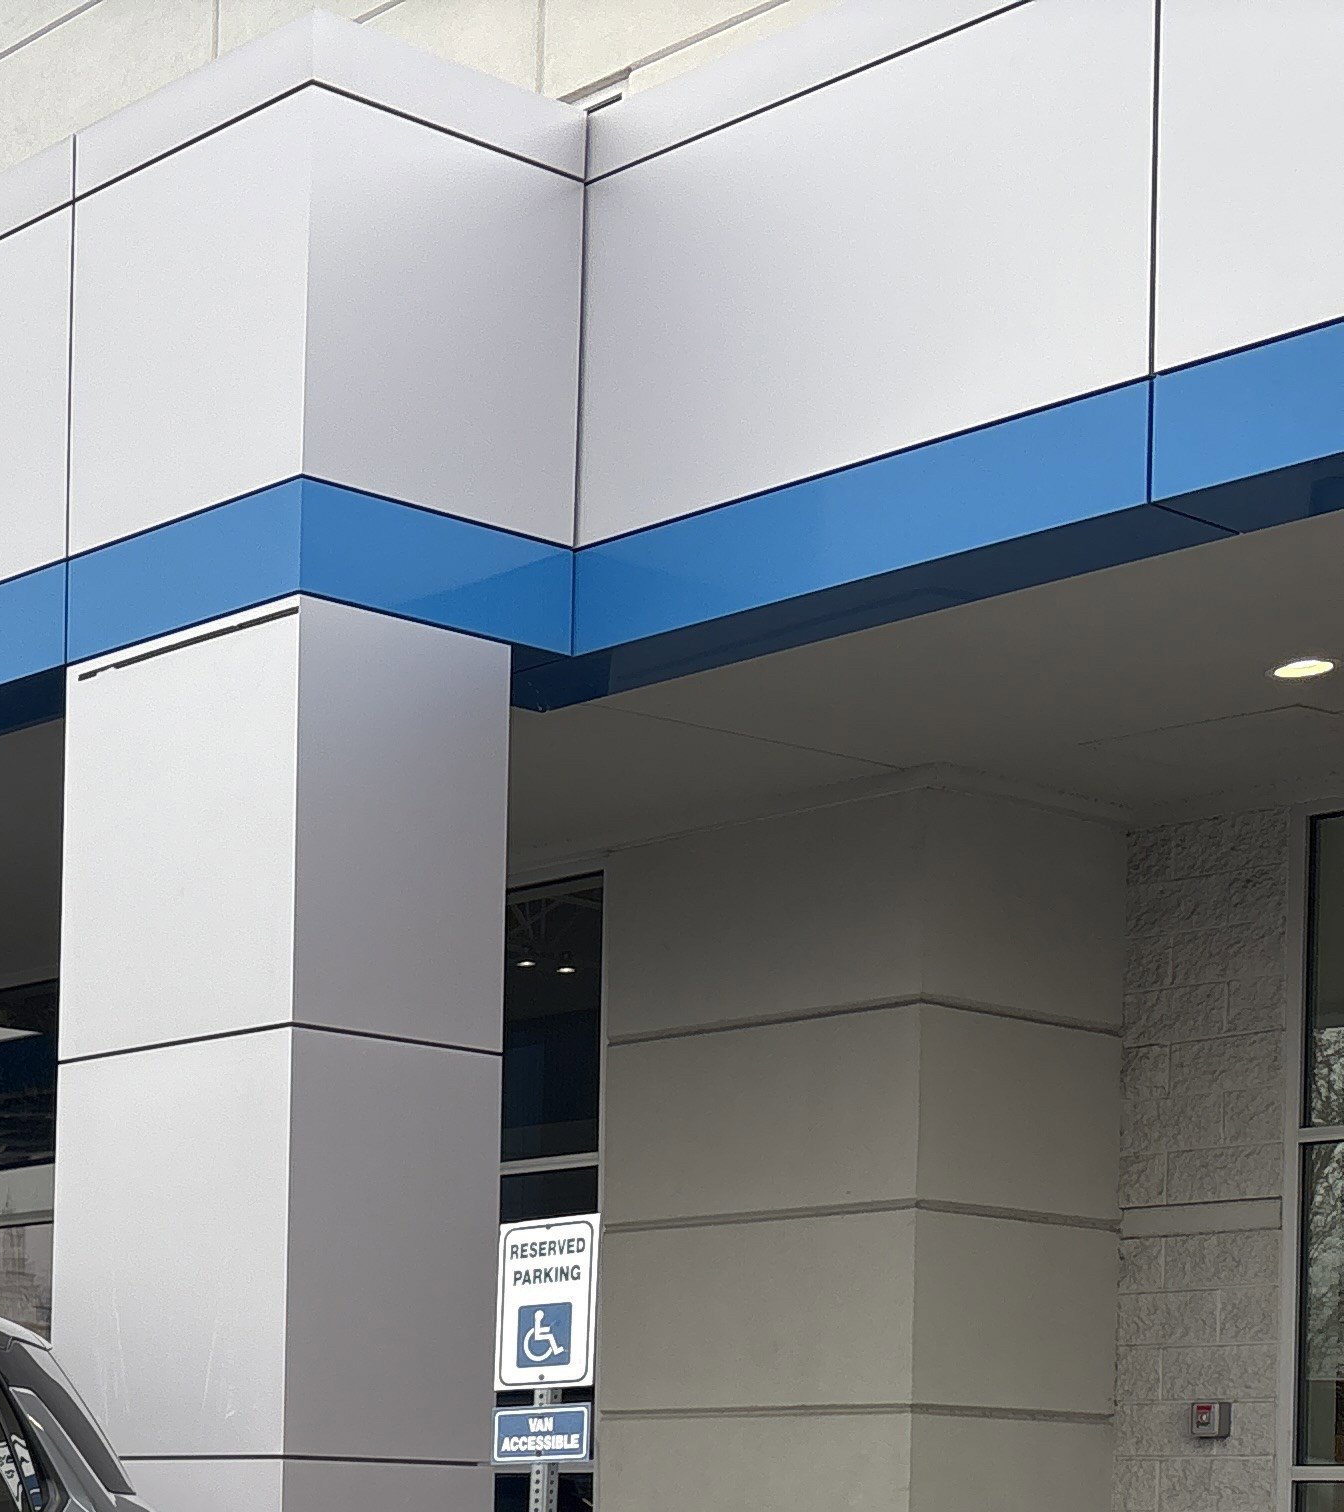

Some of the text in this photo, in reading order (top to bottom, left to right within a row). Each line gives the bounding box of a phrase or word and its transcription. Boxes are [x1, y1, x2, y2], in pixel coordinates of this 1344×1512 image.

[510, 1237, 586, 1260] RESERVED
[512, 1264, 582, 1287] PARKING
[528, 1416, 554, 1433] VAN
[500, 1434, 580, 1452] ACCESSIBLE
